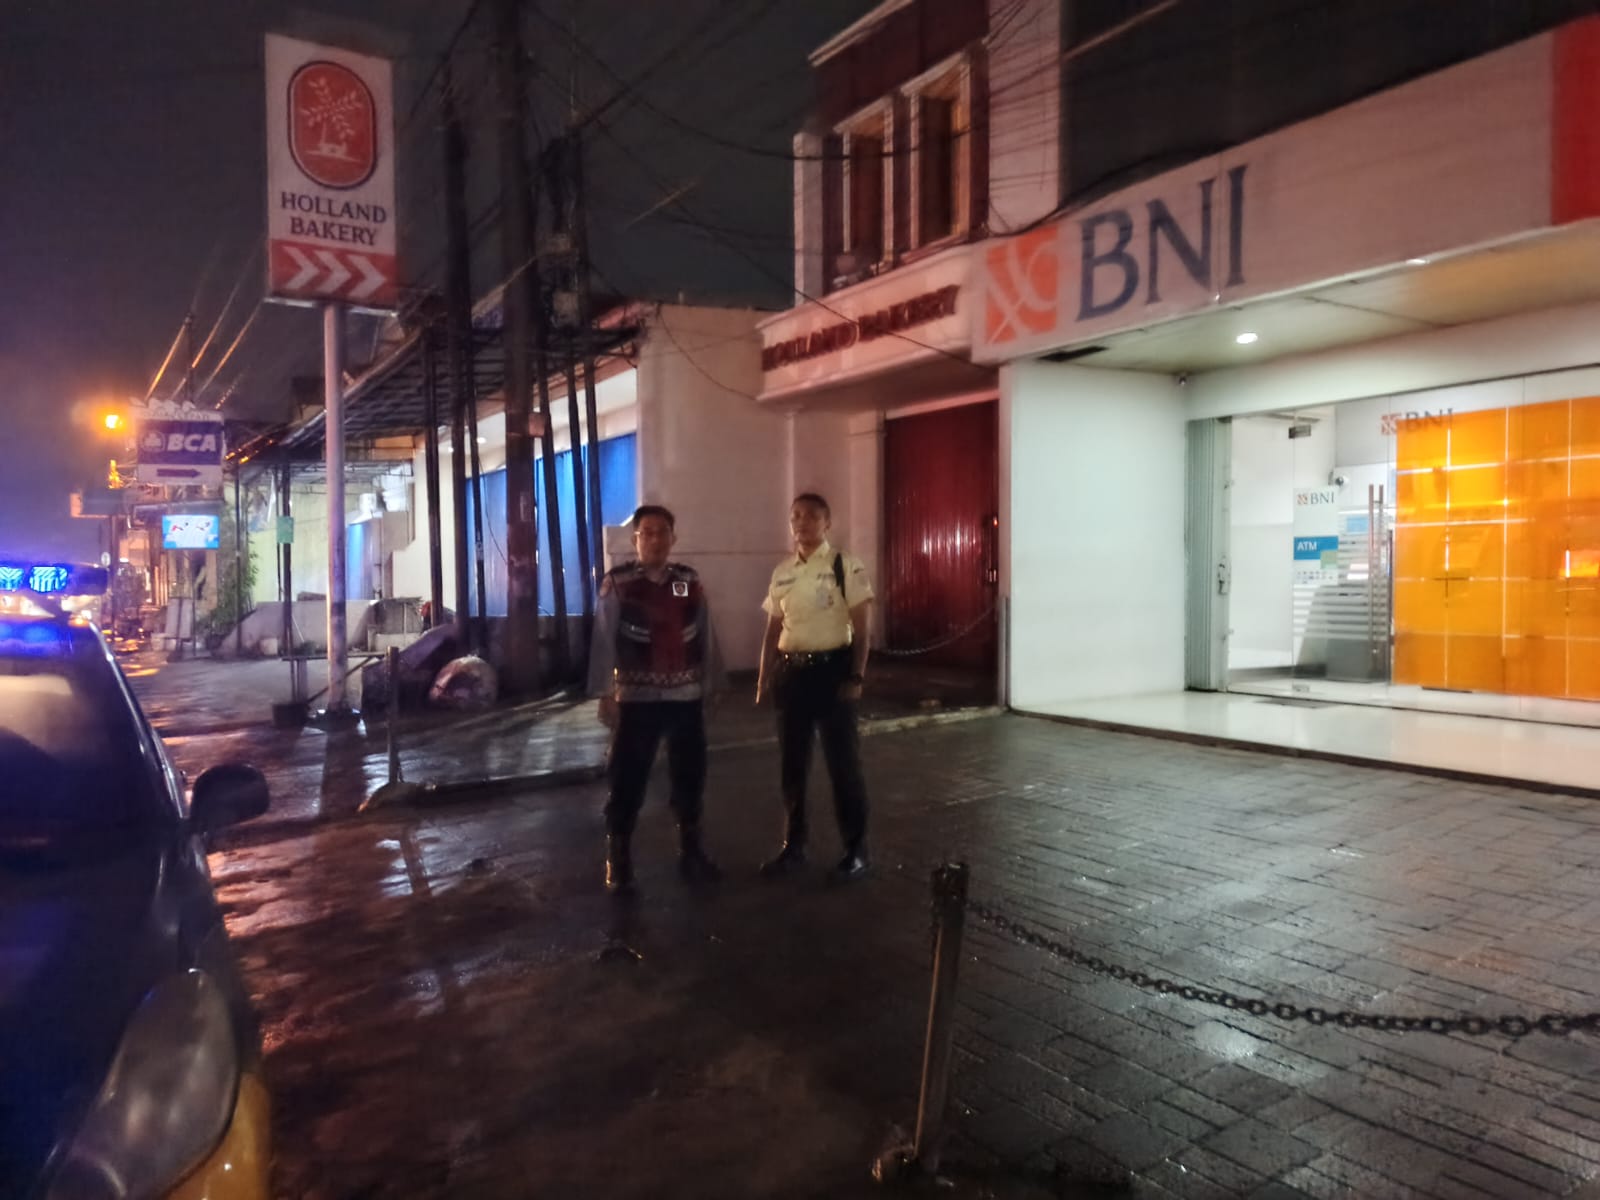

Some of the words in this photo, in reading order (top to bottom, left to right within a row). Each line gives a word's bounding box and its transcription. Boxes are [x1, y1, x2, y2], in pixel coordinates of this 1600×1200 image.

[281, 192, 386, 223] HOLLAND
[290, 217, 377, 246] BAKERY
[1076, 165, 1247, 322] BNI
[1406, 408, 1453, 432] BNI
[167, 433, 217, 452] BCA
[1310, 491, 1335, 504] BNI
[1297, 541, 1318, 550] ATM
